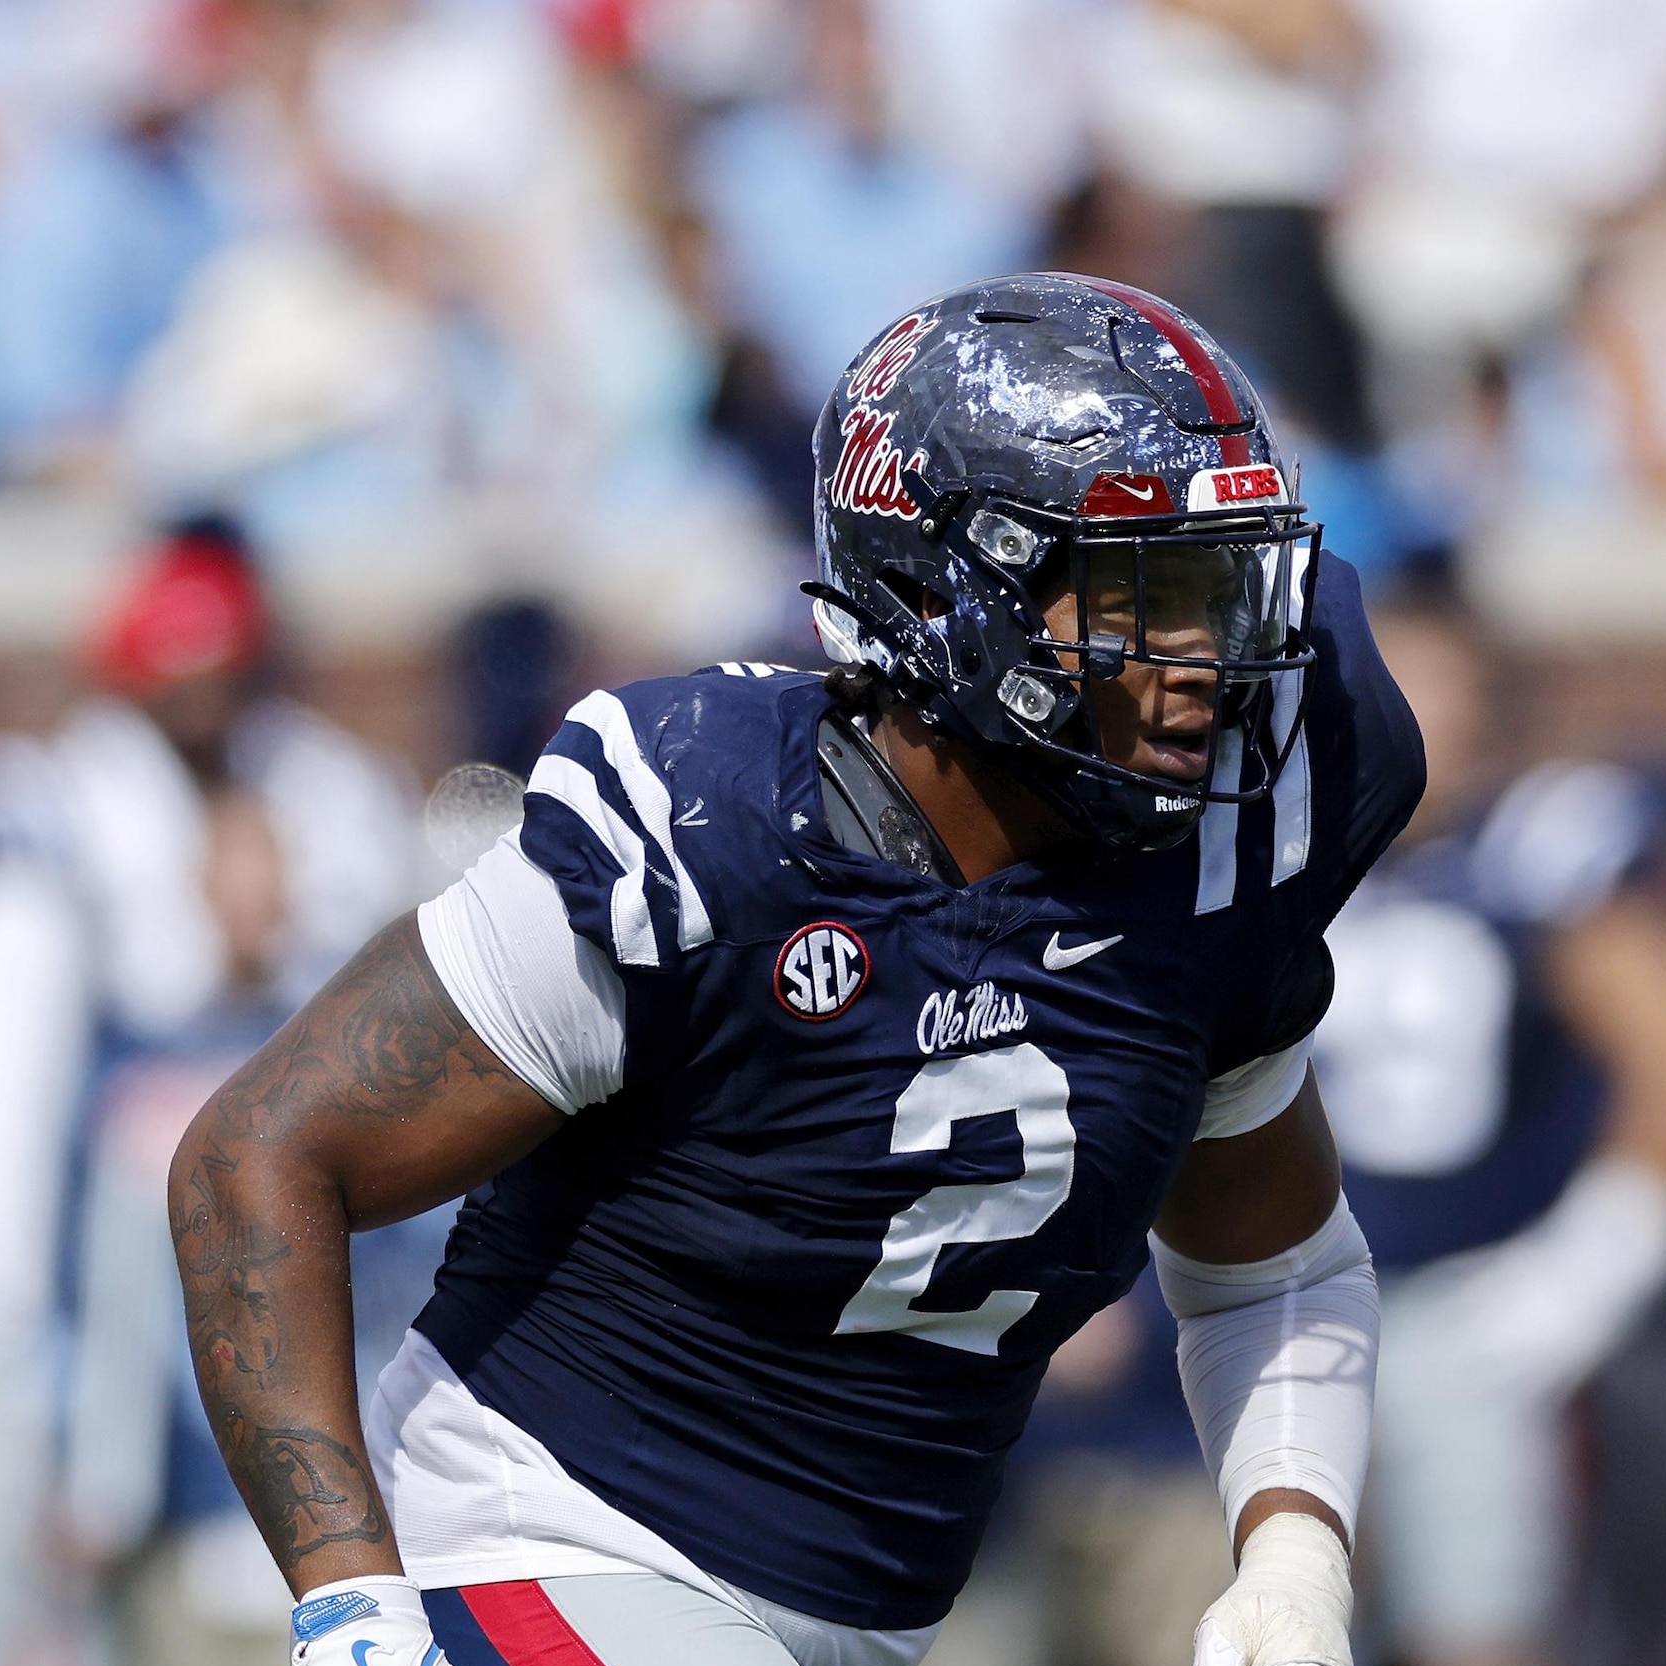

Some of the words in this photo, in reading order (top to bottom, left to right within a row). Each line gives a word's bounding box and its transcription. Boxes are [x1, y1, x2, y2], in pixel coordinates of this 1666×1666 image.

[846, 313, 941, 401] Ole
[1211, 468, 1280, 502] REBS
[1155, 795, 1200, 812] Ridde
[783, 929, 861, 1013] SEC
[917, 989, 964, 1054] Ole
[964, 981, 1029, 1044] Miss
[833, 1041, 1076, 1356] 2
